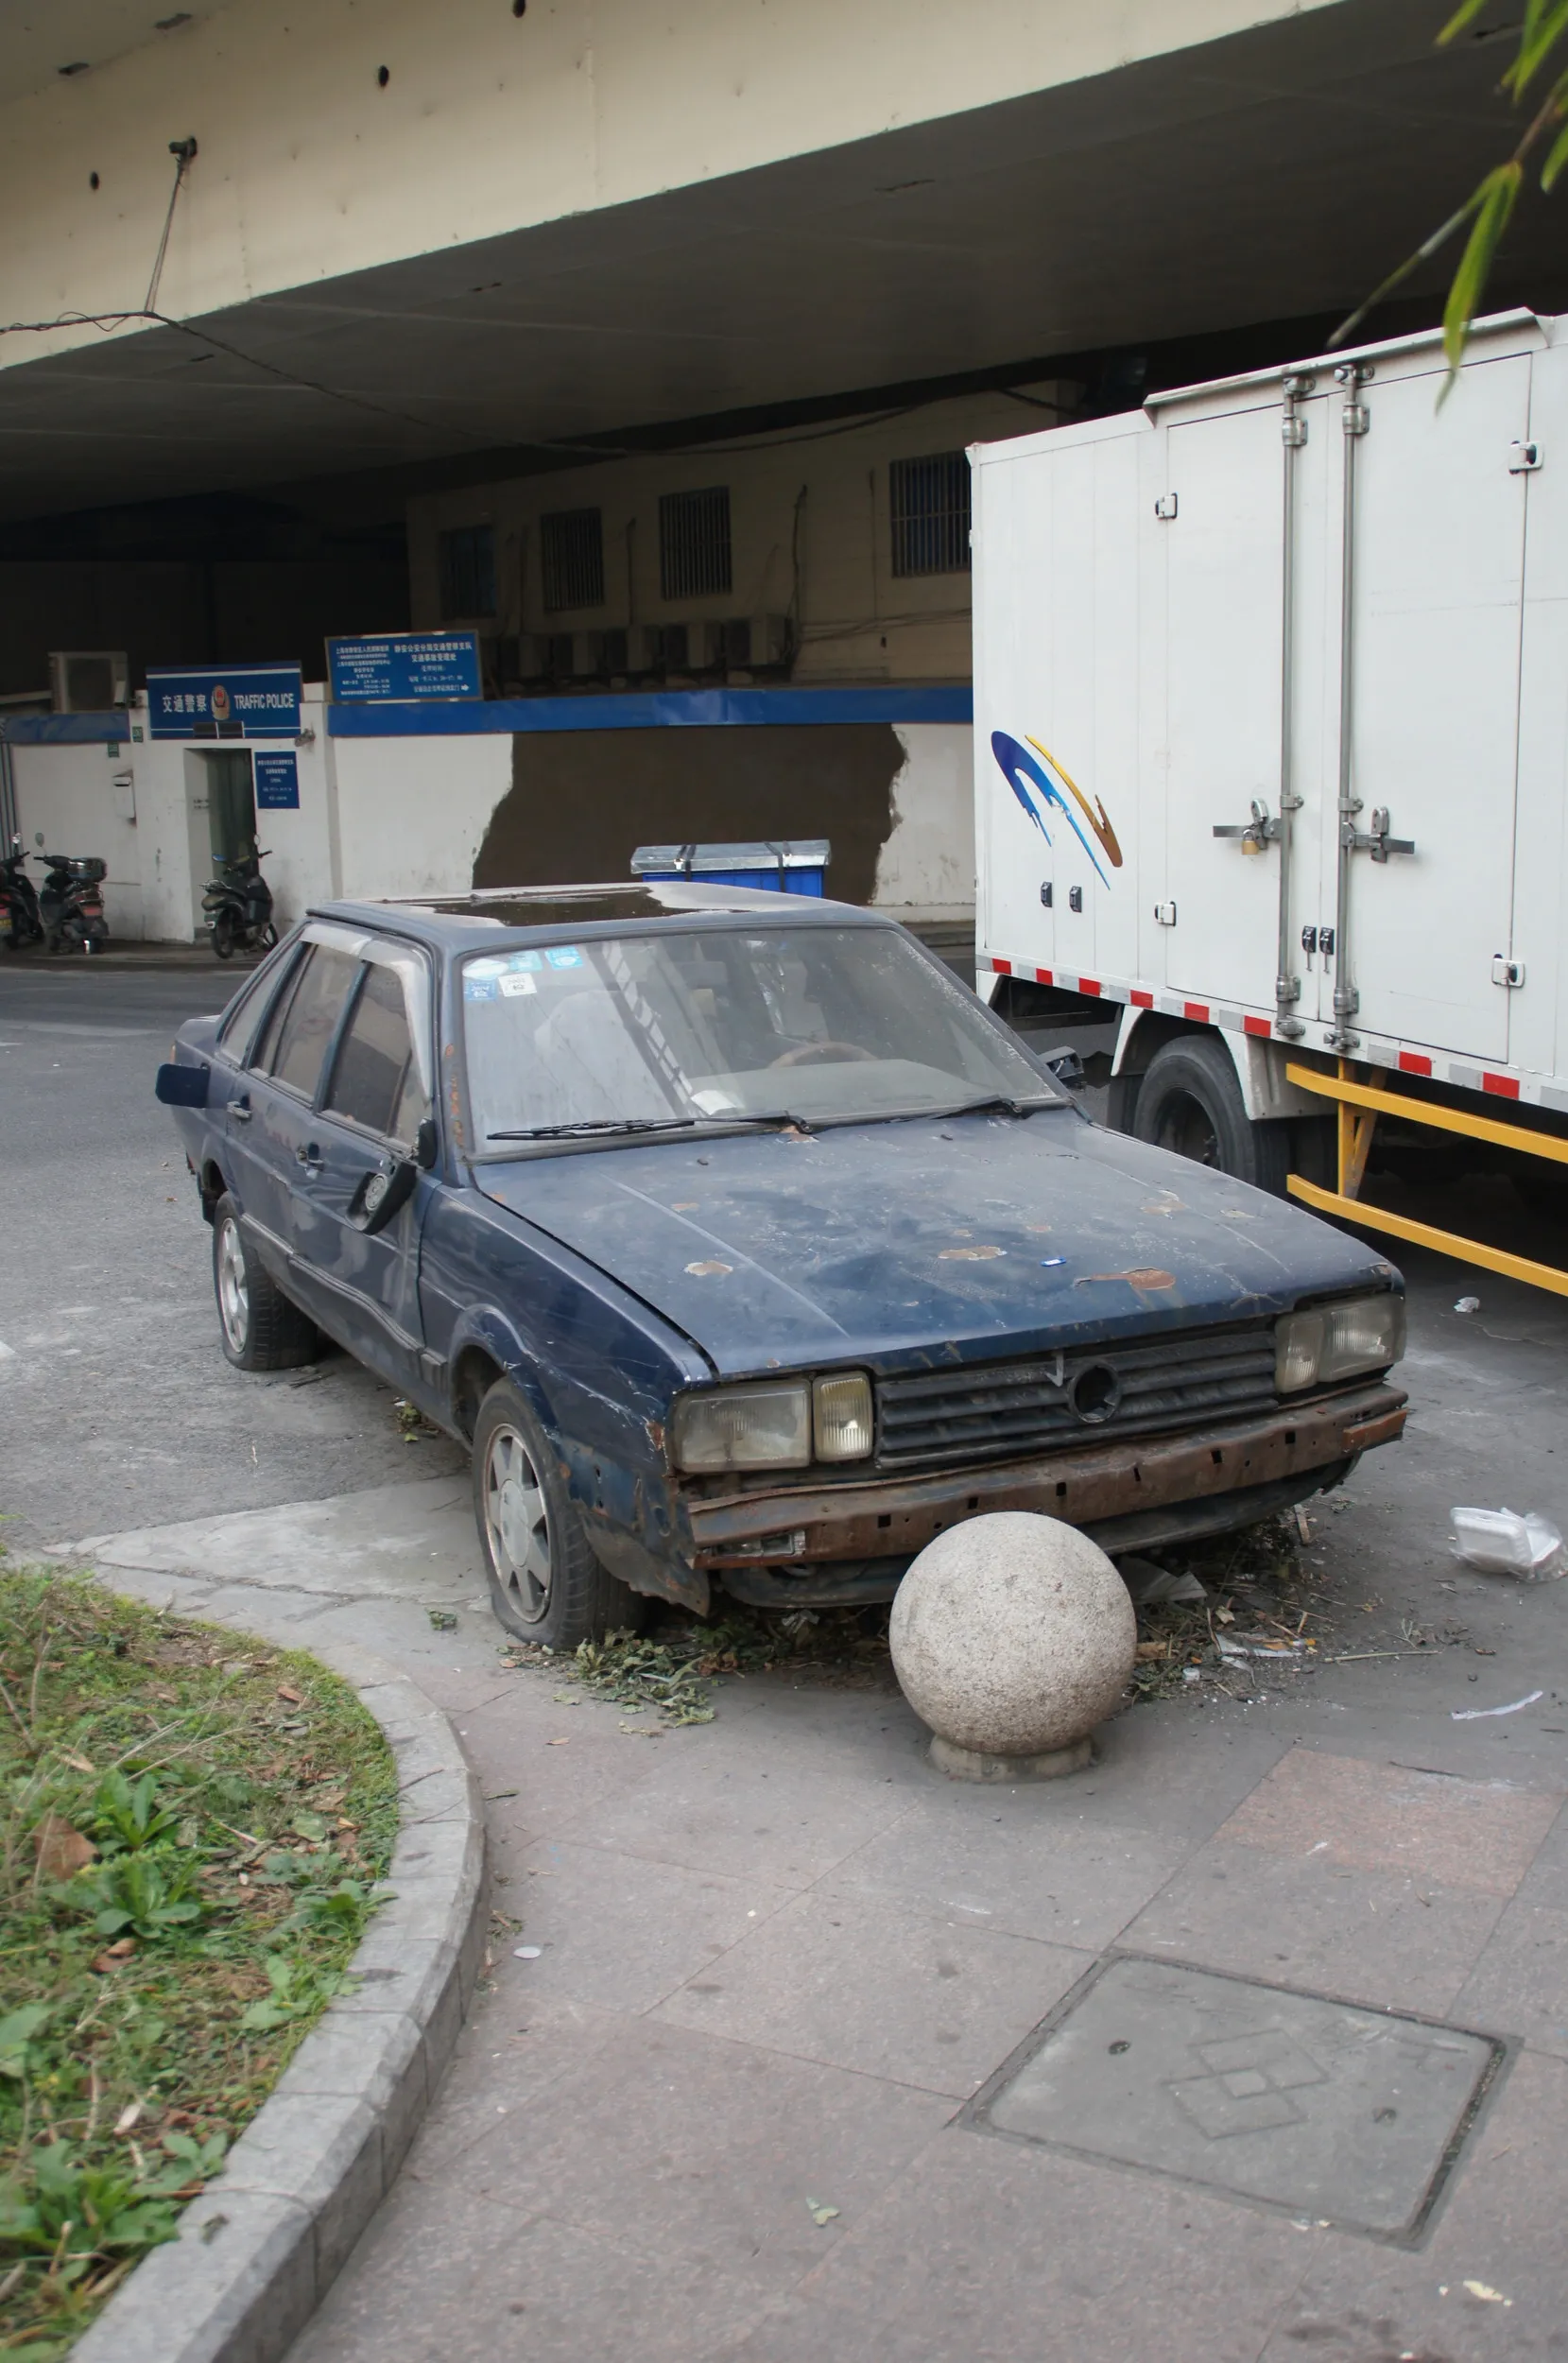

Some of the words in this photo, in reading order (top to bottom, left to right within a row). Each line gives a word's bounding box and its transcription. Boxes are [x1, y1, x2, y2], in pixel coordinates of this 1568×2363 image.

[162, 694, 207, 713] 交通警察
[233, 695, 267, 710] TRAFFIC
[267, 693, 294, 709] POLICE
